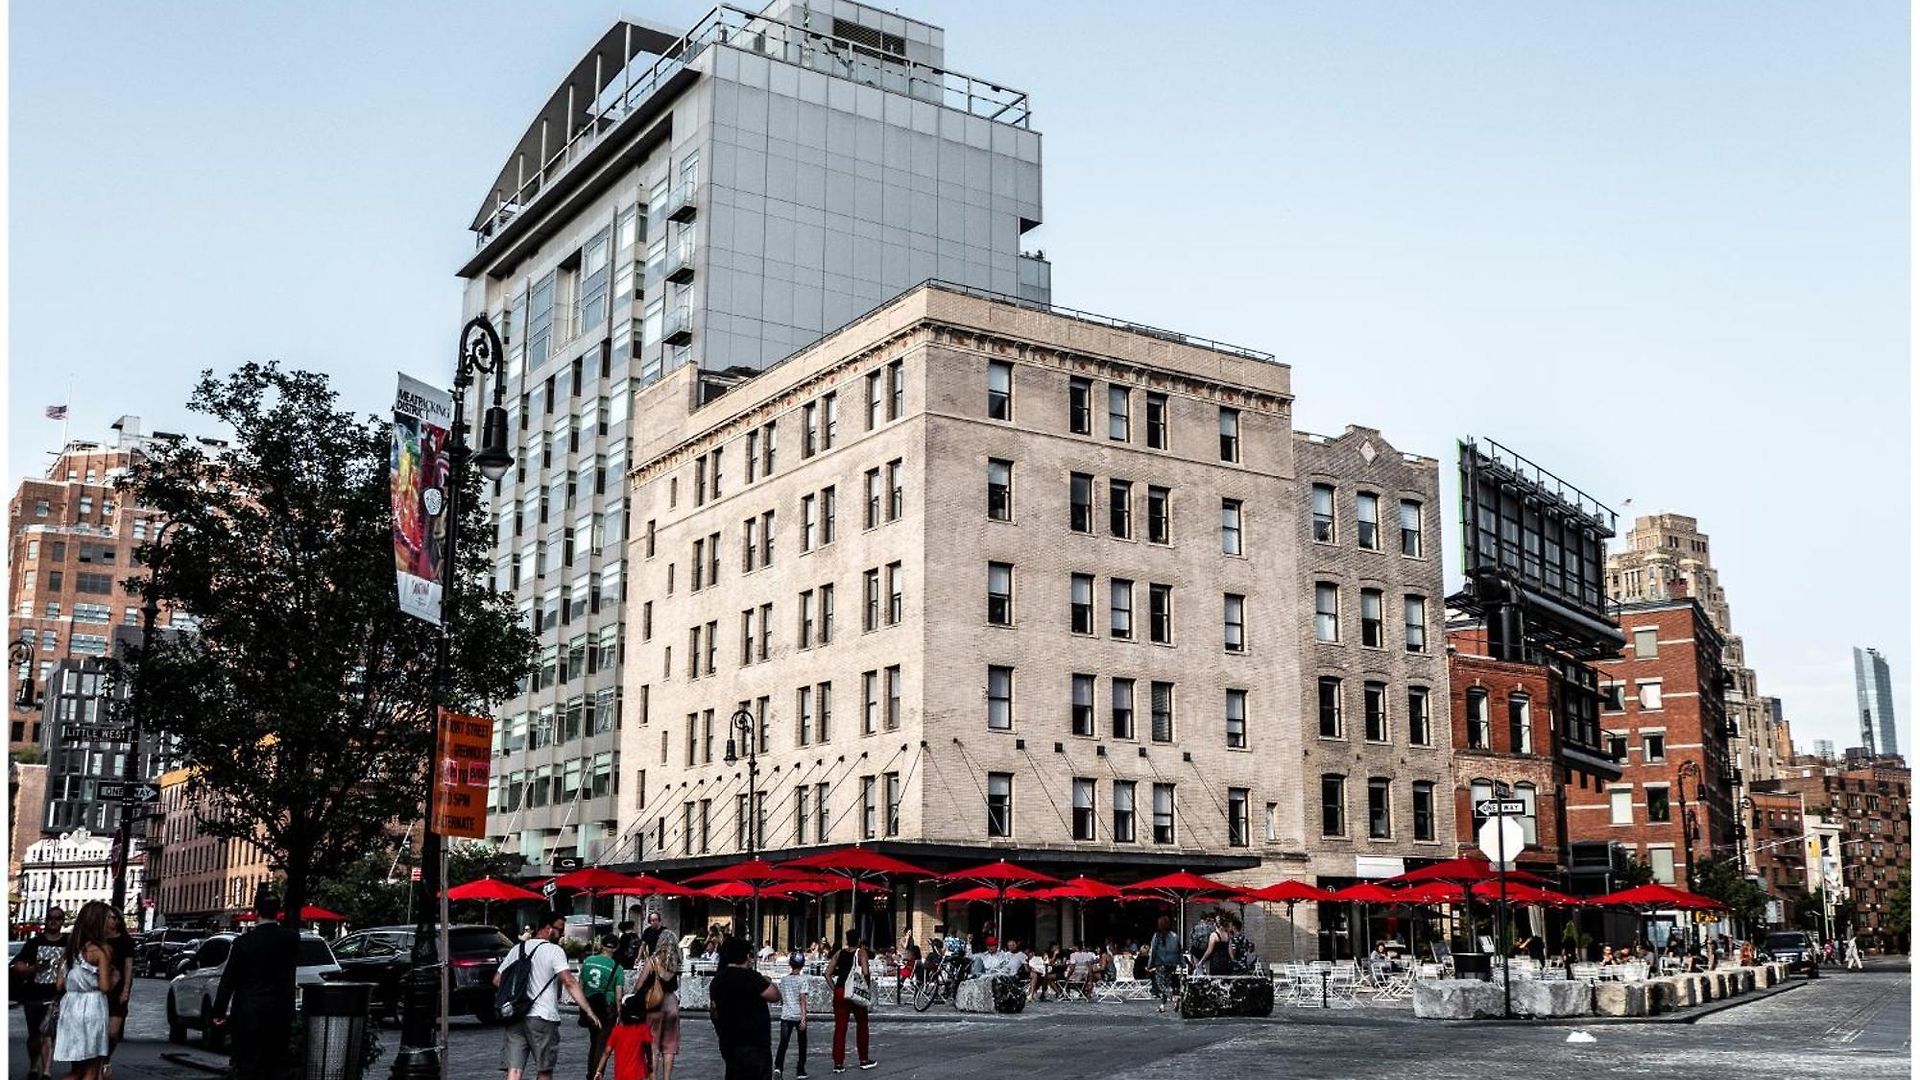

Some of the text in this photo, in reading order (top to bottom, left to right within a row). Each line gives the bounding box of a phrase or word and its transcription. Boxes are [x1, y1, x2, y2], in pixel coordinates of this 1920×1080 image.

[396, 400, 430, 420] DISTRICT
[398, 389, 450, 418] MEATPACKING
[67, 728, 126, 739] LITTLE WEST
[466, 722, 490, 737] STREET
[105, 787, 124, 796] ONE
[1483, 804, 1496, 812] ONE
[587, 968, 601, 989] 3
